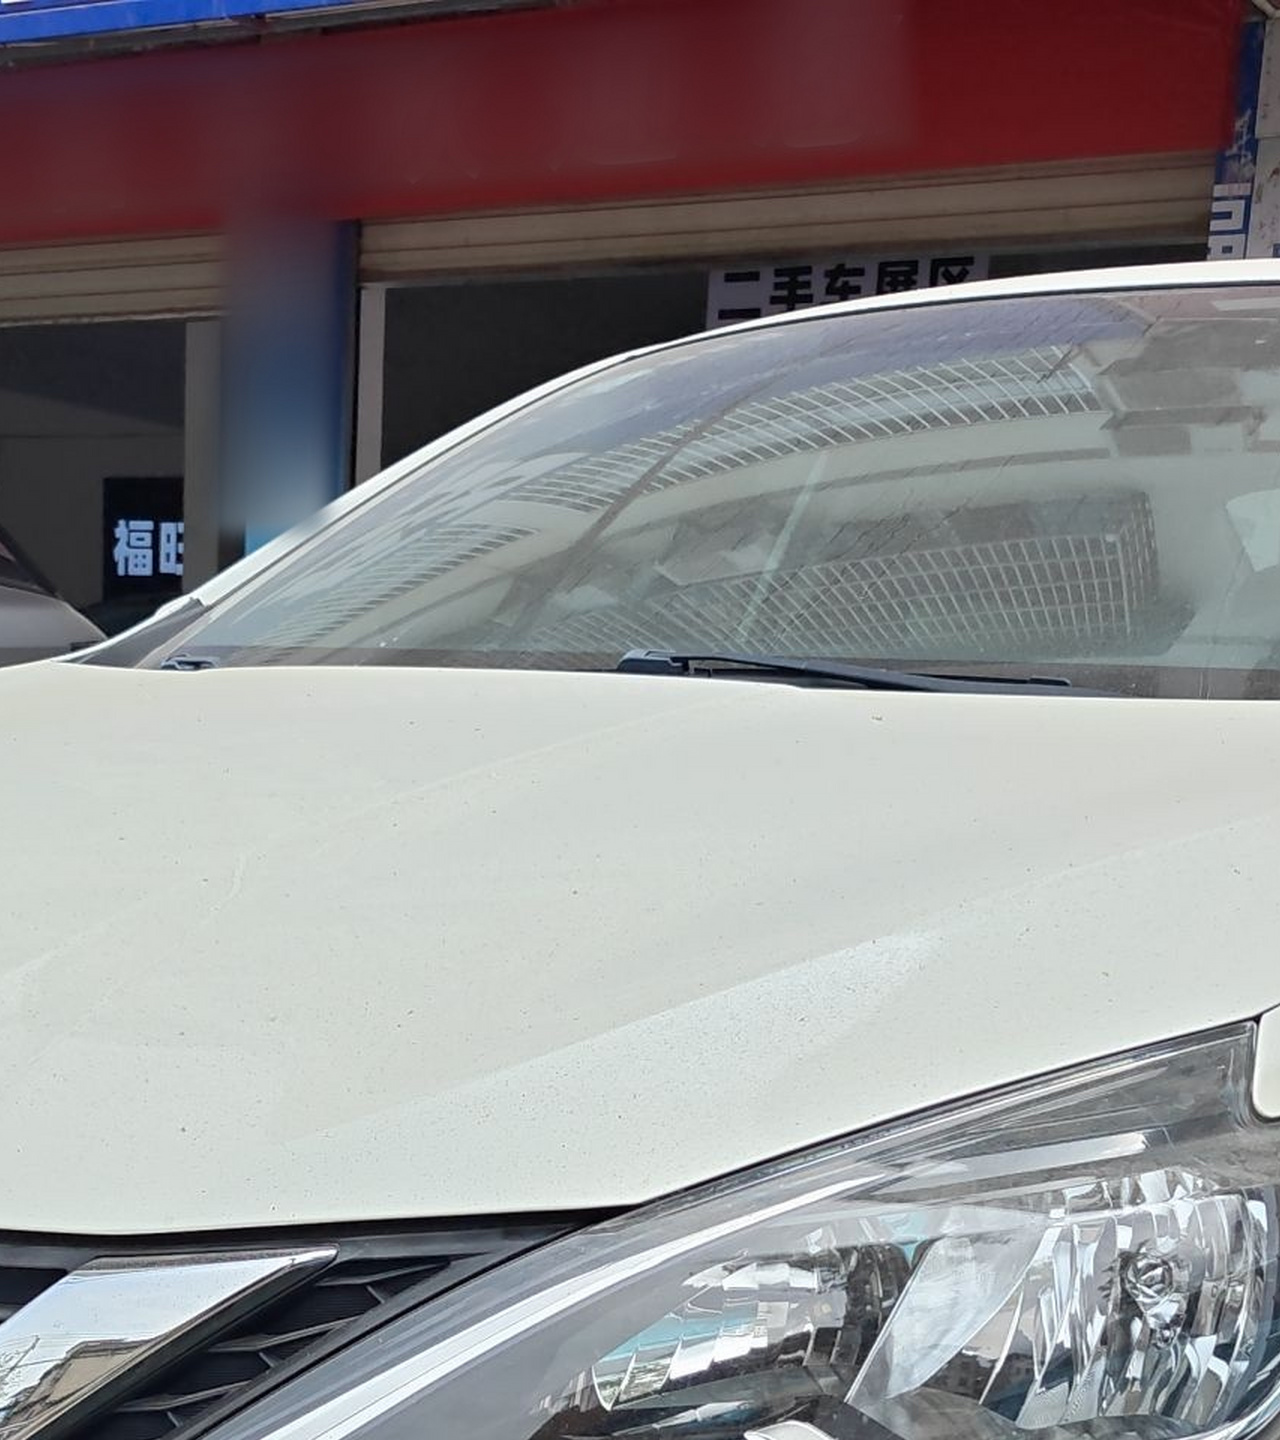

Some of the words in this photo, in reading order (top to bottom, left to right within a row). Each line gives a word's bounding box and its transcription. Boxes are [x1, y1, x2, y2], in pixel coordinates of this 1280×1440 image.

[718, 256, 975, 320] 二手车展区
